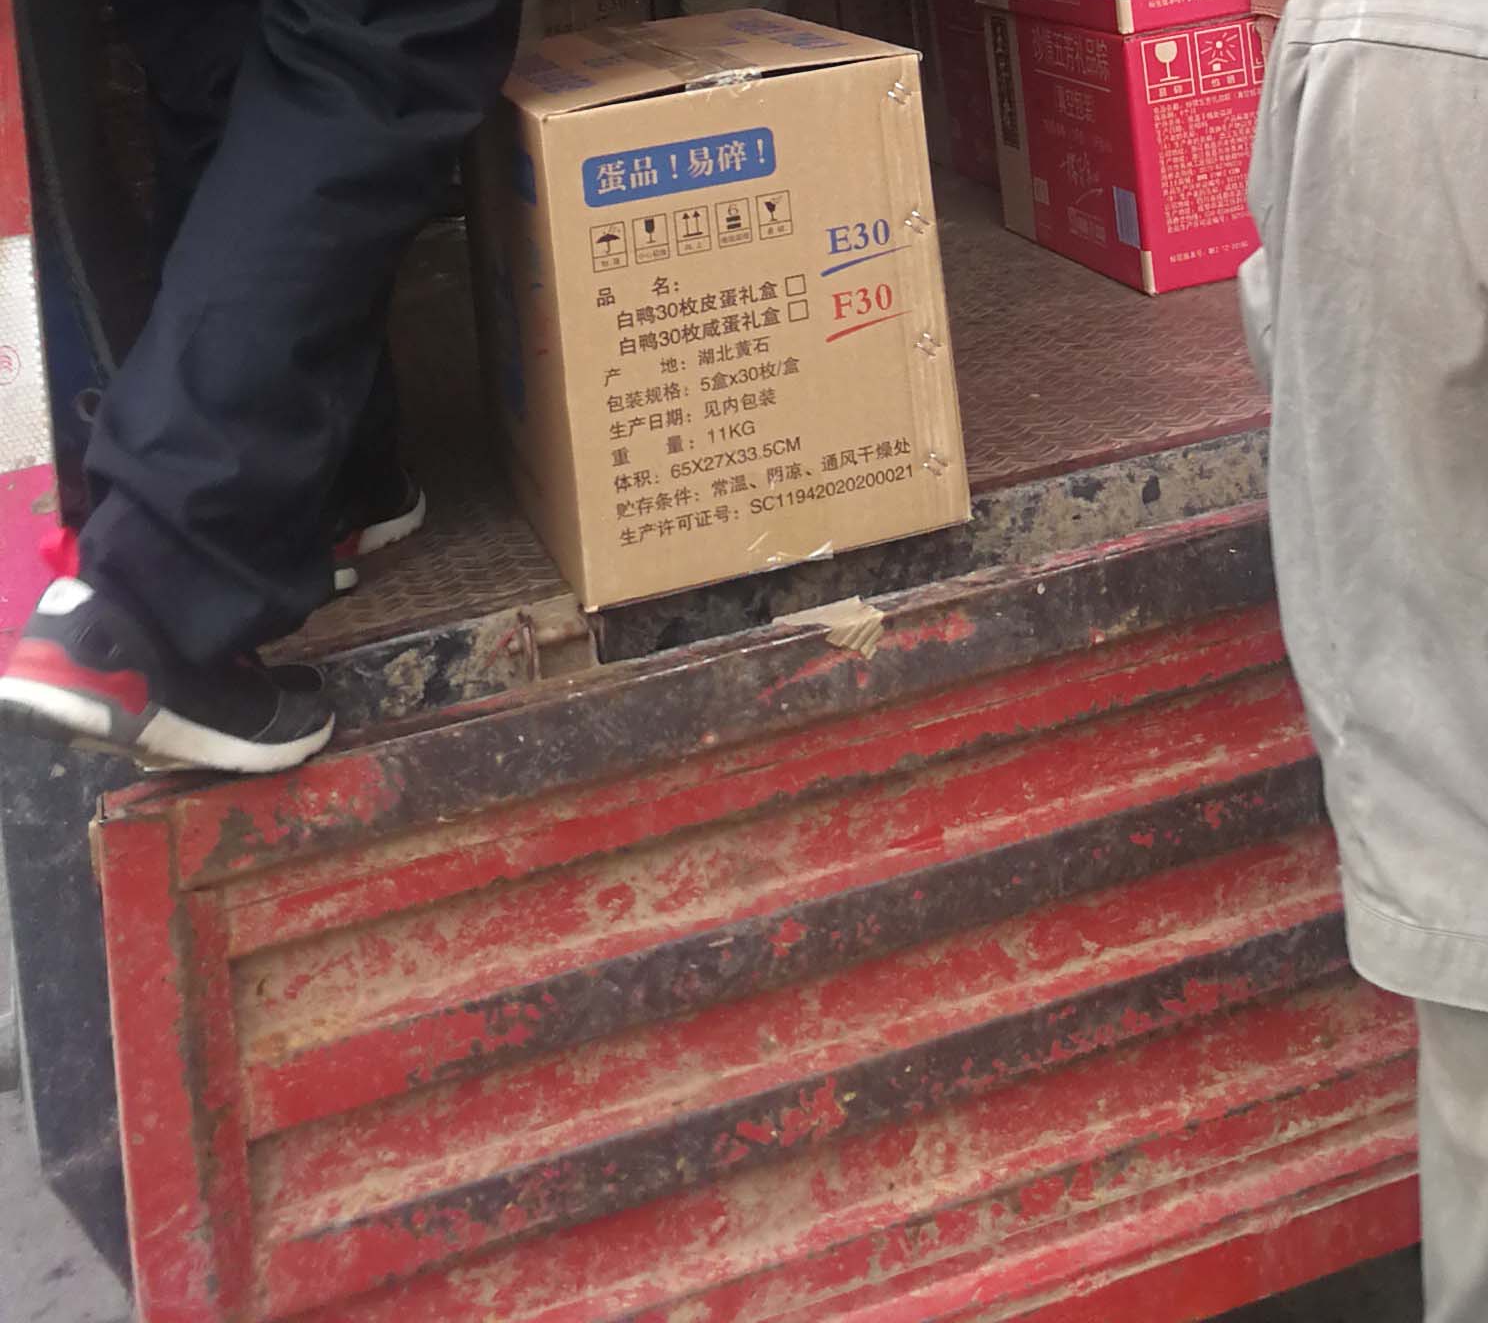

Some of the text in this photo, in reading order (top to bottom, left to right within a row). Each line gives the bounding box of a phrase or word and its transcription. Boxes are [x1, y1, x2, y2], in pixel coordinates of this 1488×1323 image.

[597, 138, 766, 195] 蛋品！易碎！
[825, 218, 890, 255] E30
[596, 287, 616, 307] 品
[617, 280, 778, 331] 白鸭30枚皮蛋礼盒
[831, 283, 893, 320] F30
[619, 306, 780, 356] 白鸭30枚咸蛋礼盒
[604, 368, 621, 387] 产
[698, 335, 770, 366] 湖北黄石
[607, 382, 689, 413] 包装规格：
[609, 388, 777, 440] 生产日期： 见内包装
[612, 446, 631, 467] 重
[708, 420, 756, 444] 11KG
[614, 469, 659, 494] 体积：
[616, 487, 700, 520] 贮存条件：
[619, 464, 913, 547] 生产许可证号： SC11942020200021
